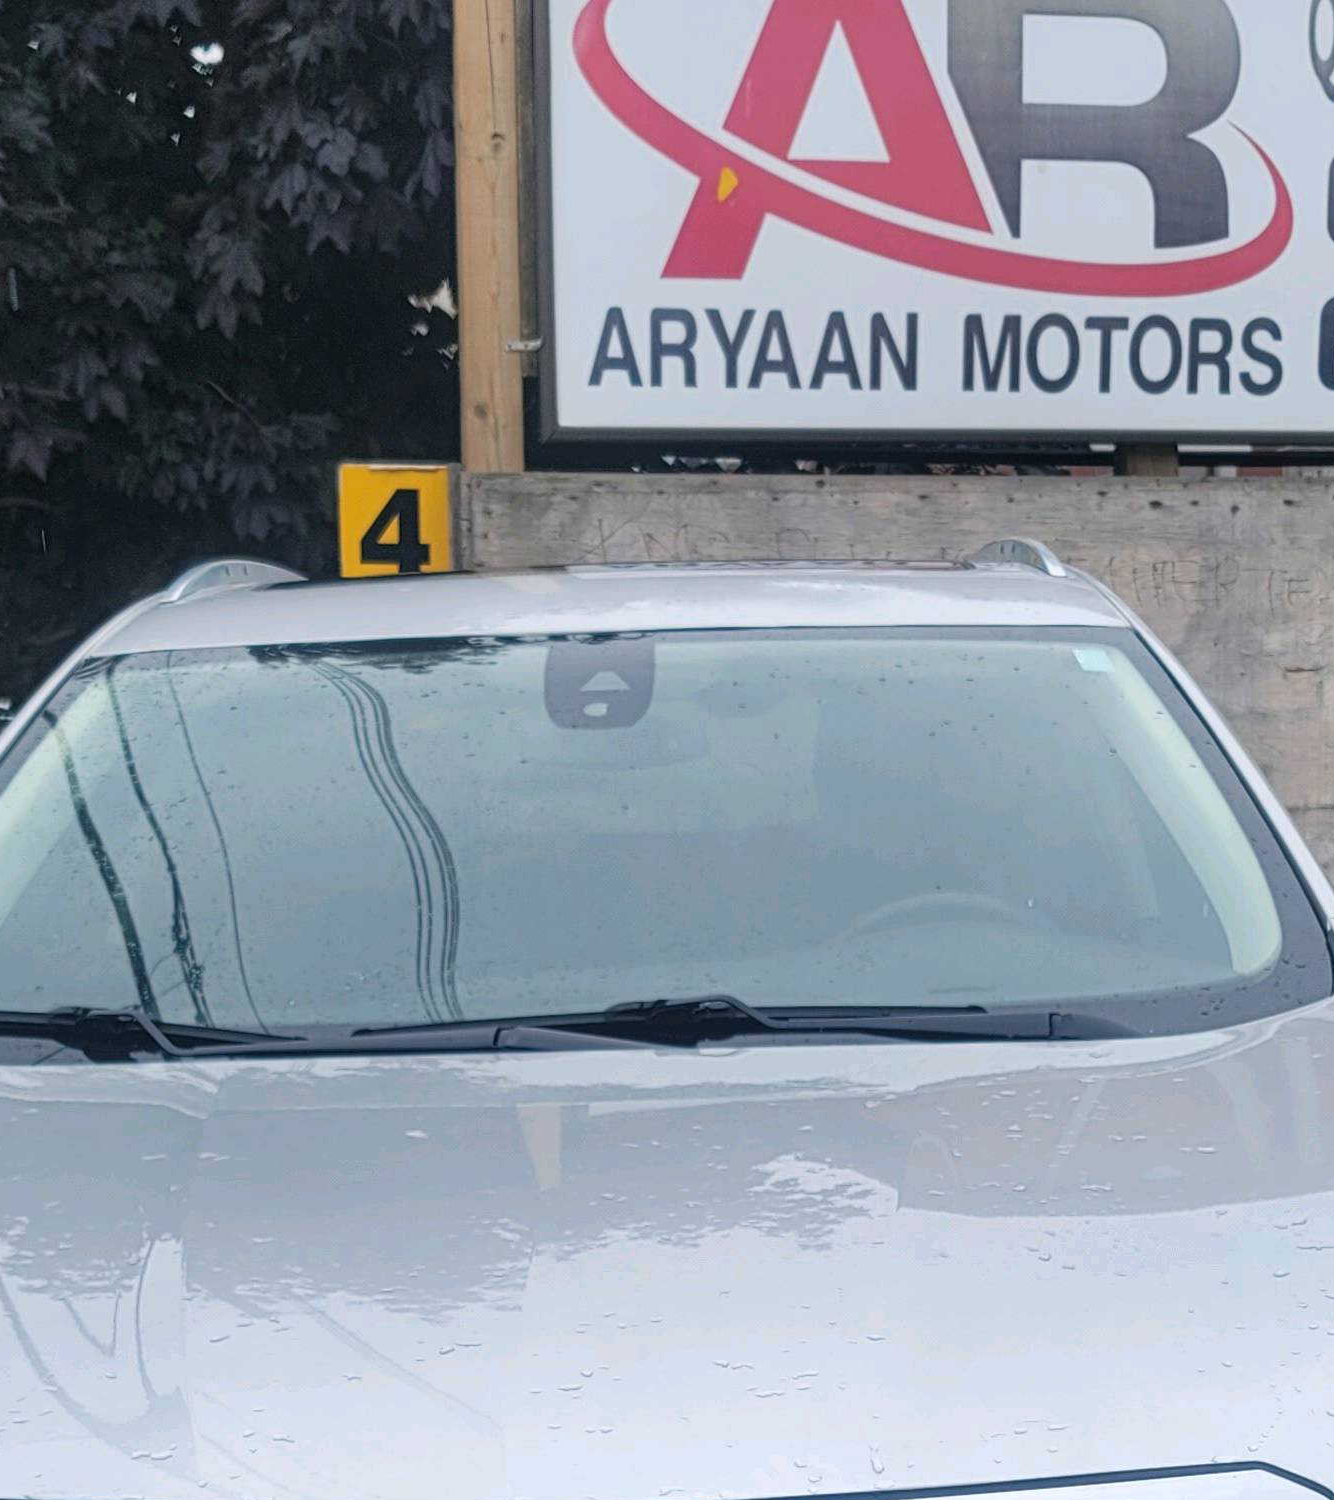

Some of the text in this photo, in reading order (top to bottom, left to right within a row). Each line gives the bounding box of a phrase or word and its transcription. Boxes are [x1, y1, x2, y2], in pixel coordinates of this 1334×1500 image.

[587, 306, 1284, 397] ARYAAN MOTORS
[360, 488, 431, 574] 4
